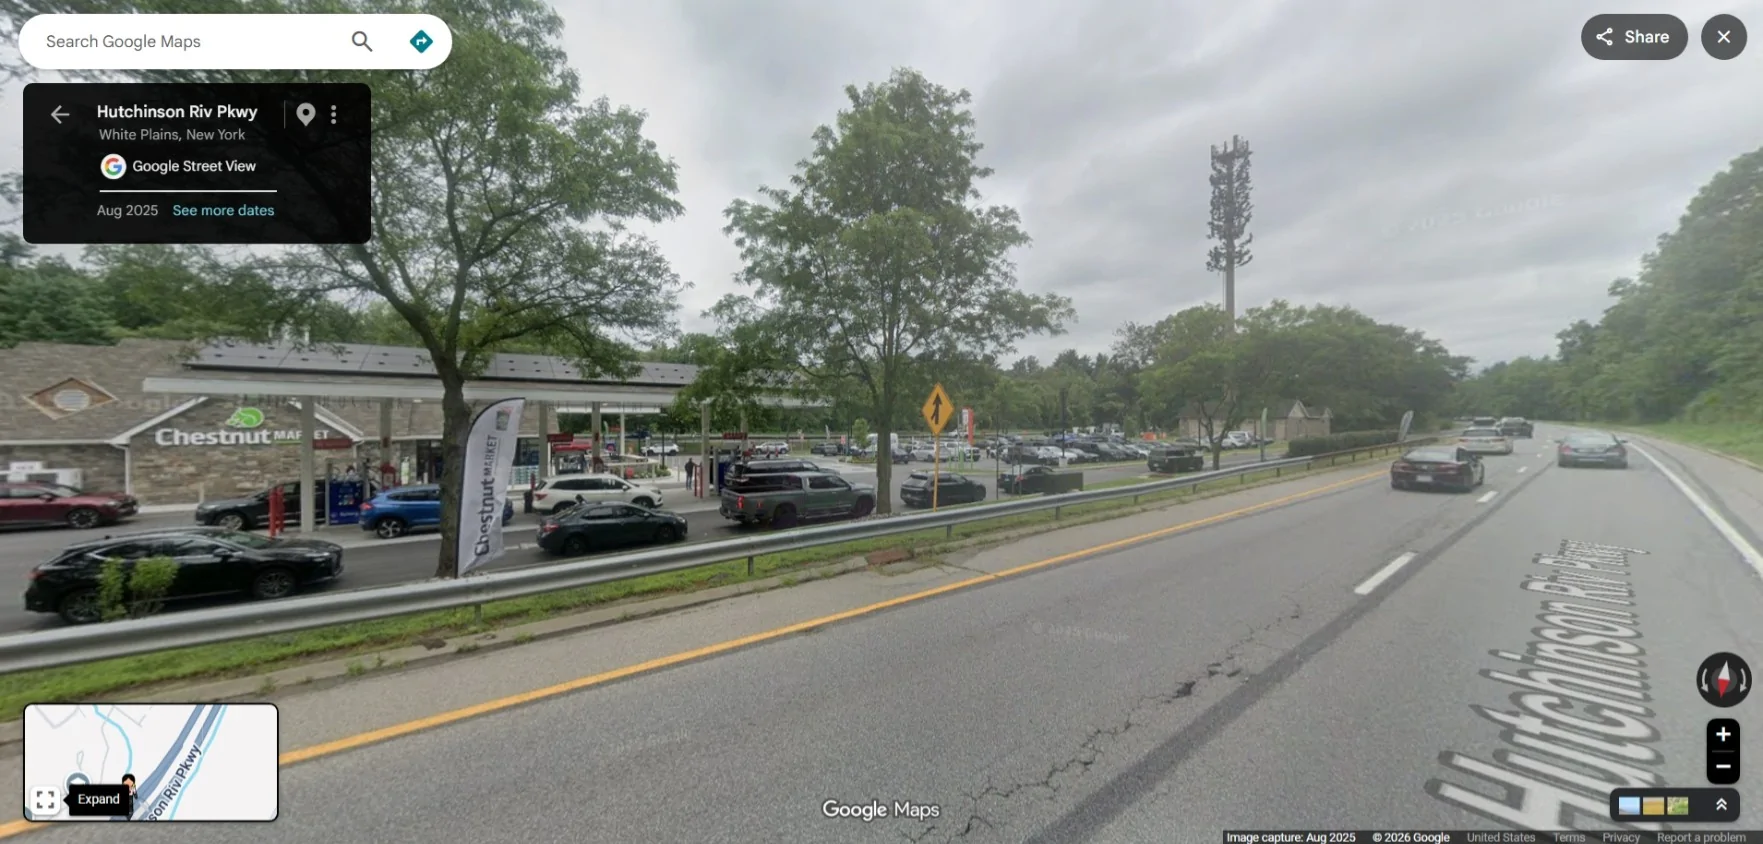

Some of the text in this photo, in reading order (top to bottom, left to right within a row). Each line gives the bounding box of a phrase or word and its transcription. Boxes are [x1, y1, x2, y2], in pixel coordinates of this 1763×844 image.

[155, 428, 330, 446] Chestnut MARET
[474, 434, 498, 557] Chestnut MARKET
